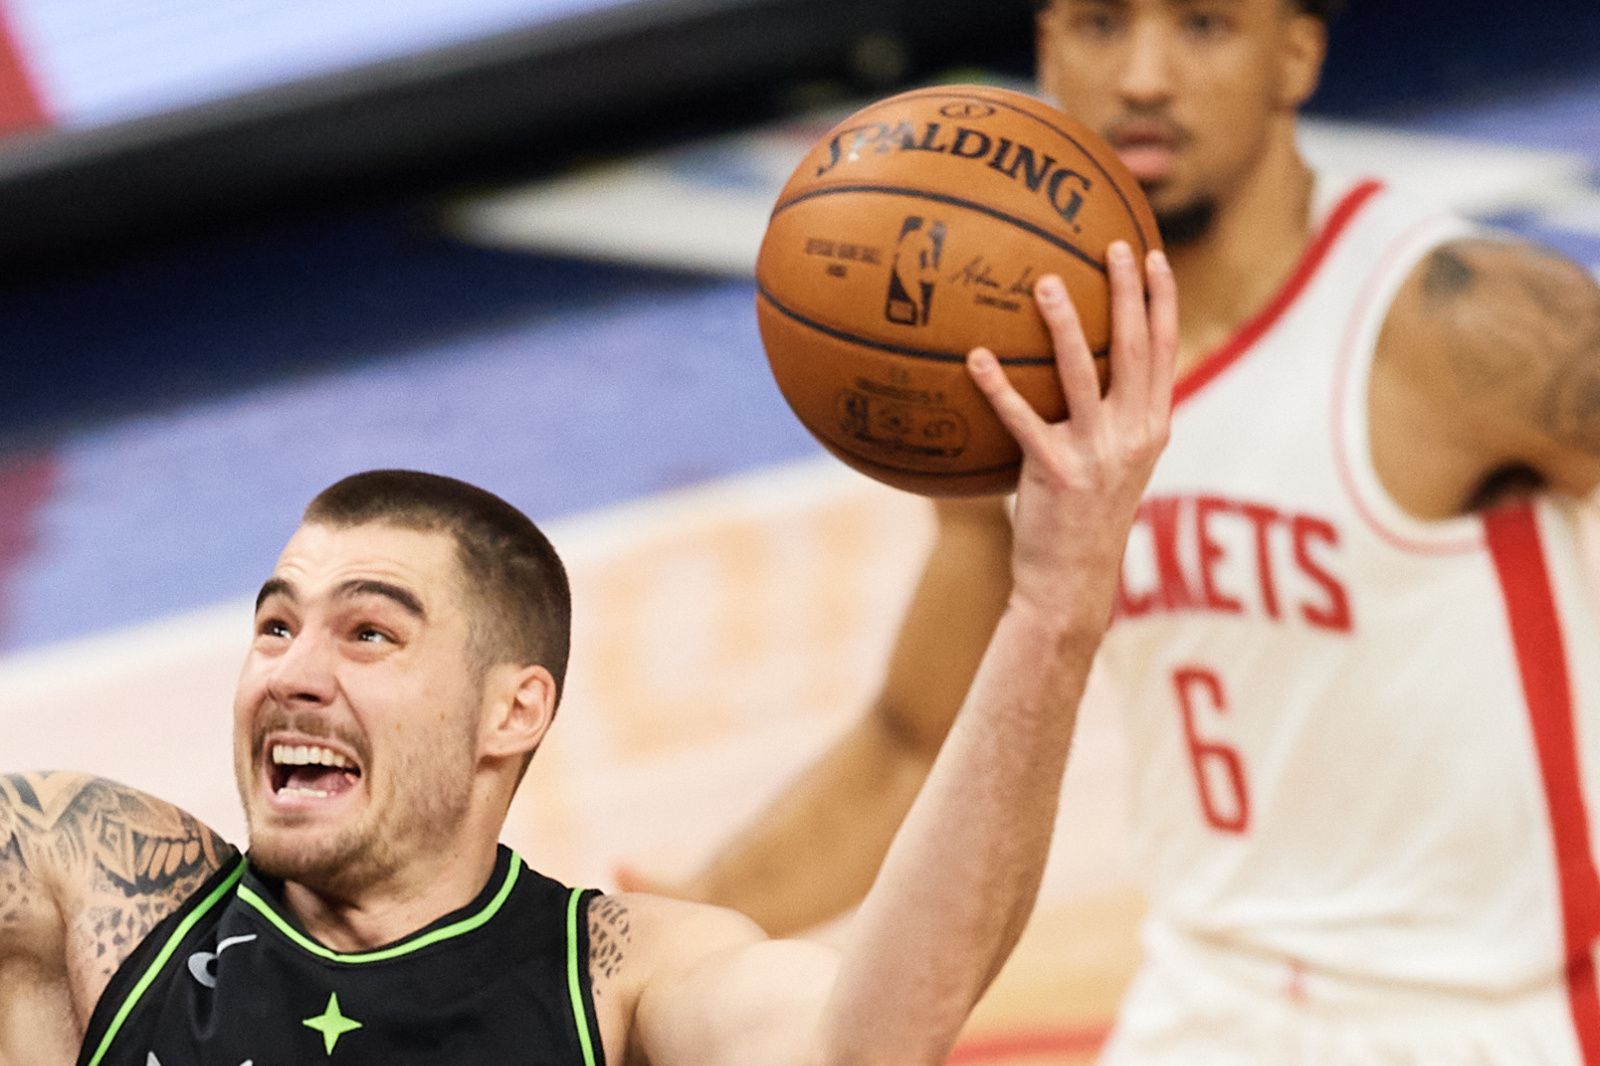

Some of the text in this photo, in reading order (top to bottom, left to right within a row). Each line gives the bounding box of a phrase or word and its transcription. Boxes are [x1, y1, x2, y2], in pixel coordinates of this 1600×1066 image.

[816, 119, 1092, 224] SPALDING
[1106, 492, 1354, 635] CKETS
[1171, 664, 1251, 834] 6
